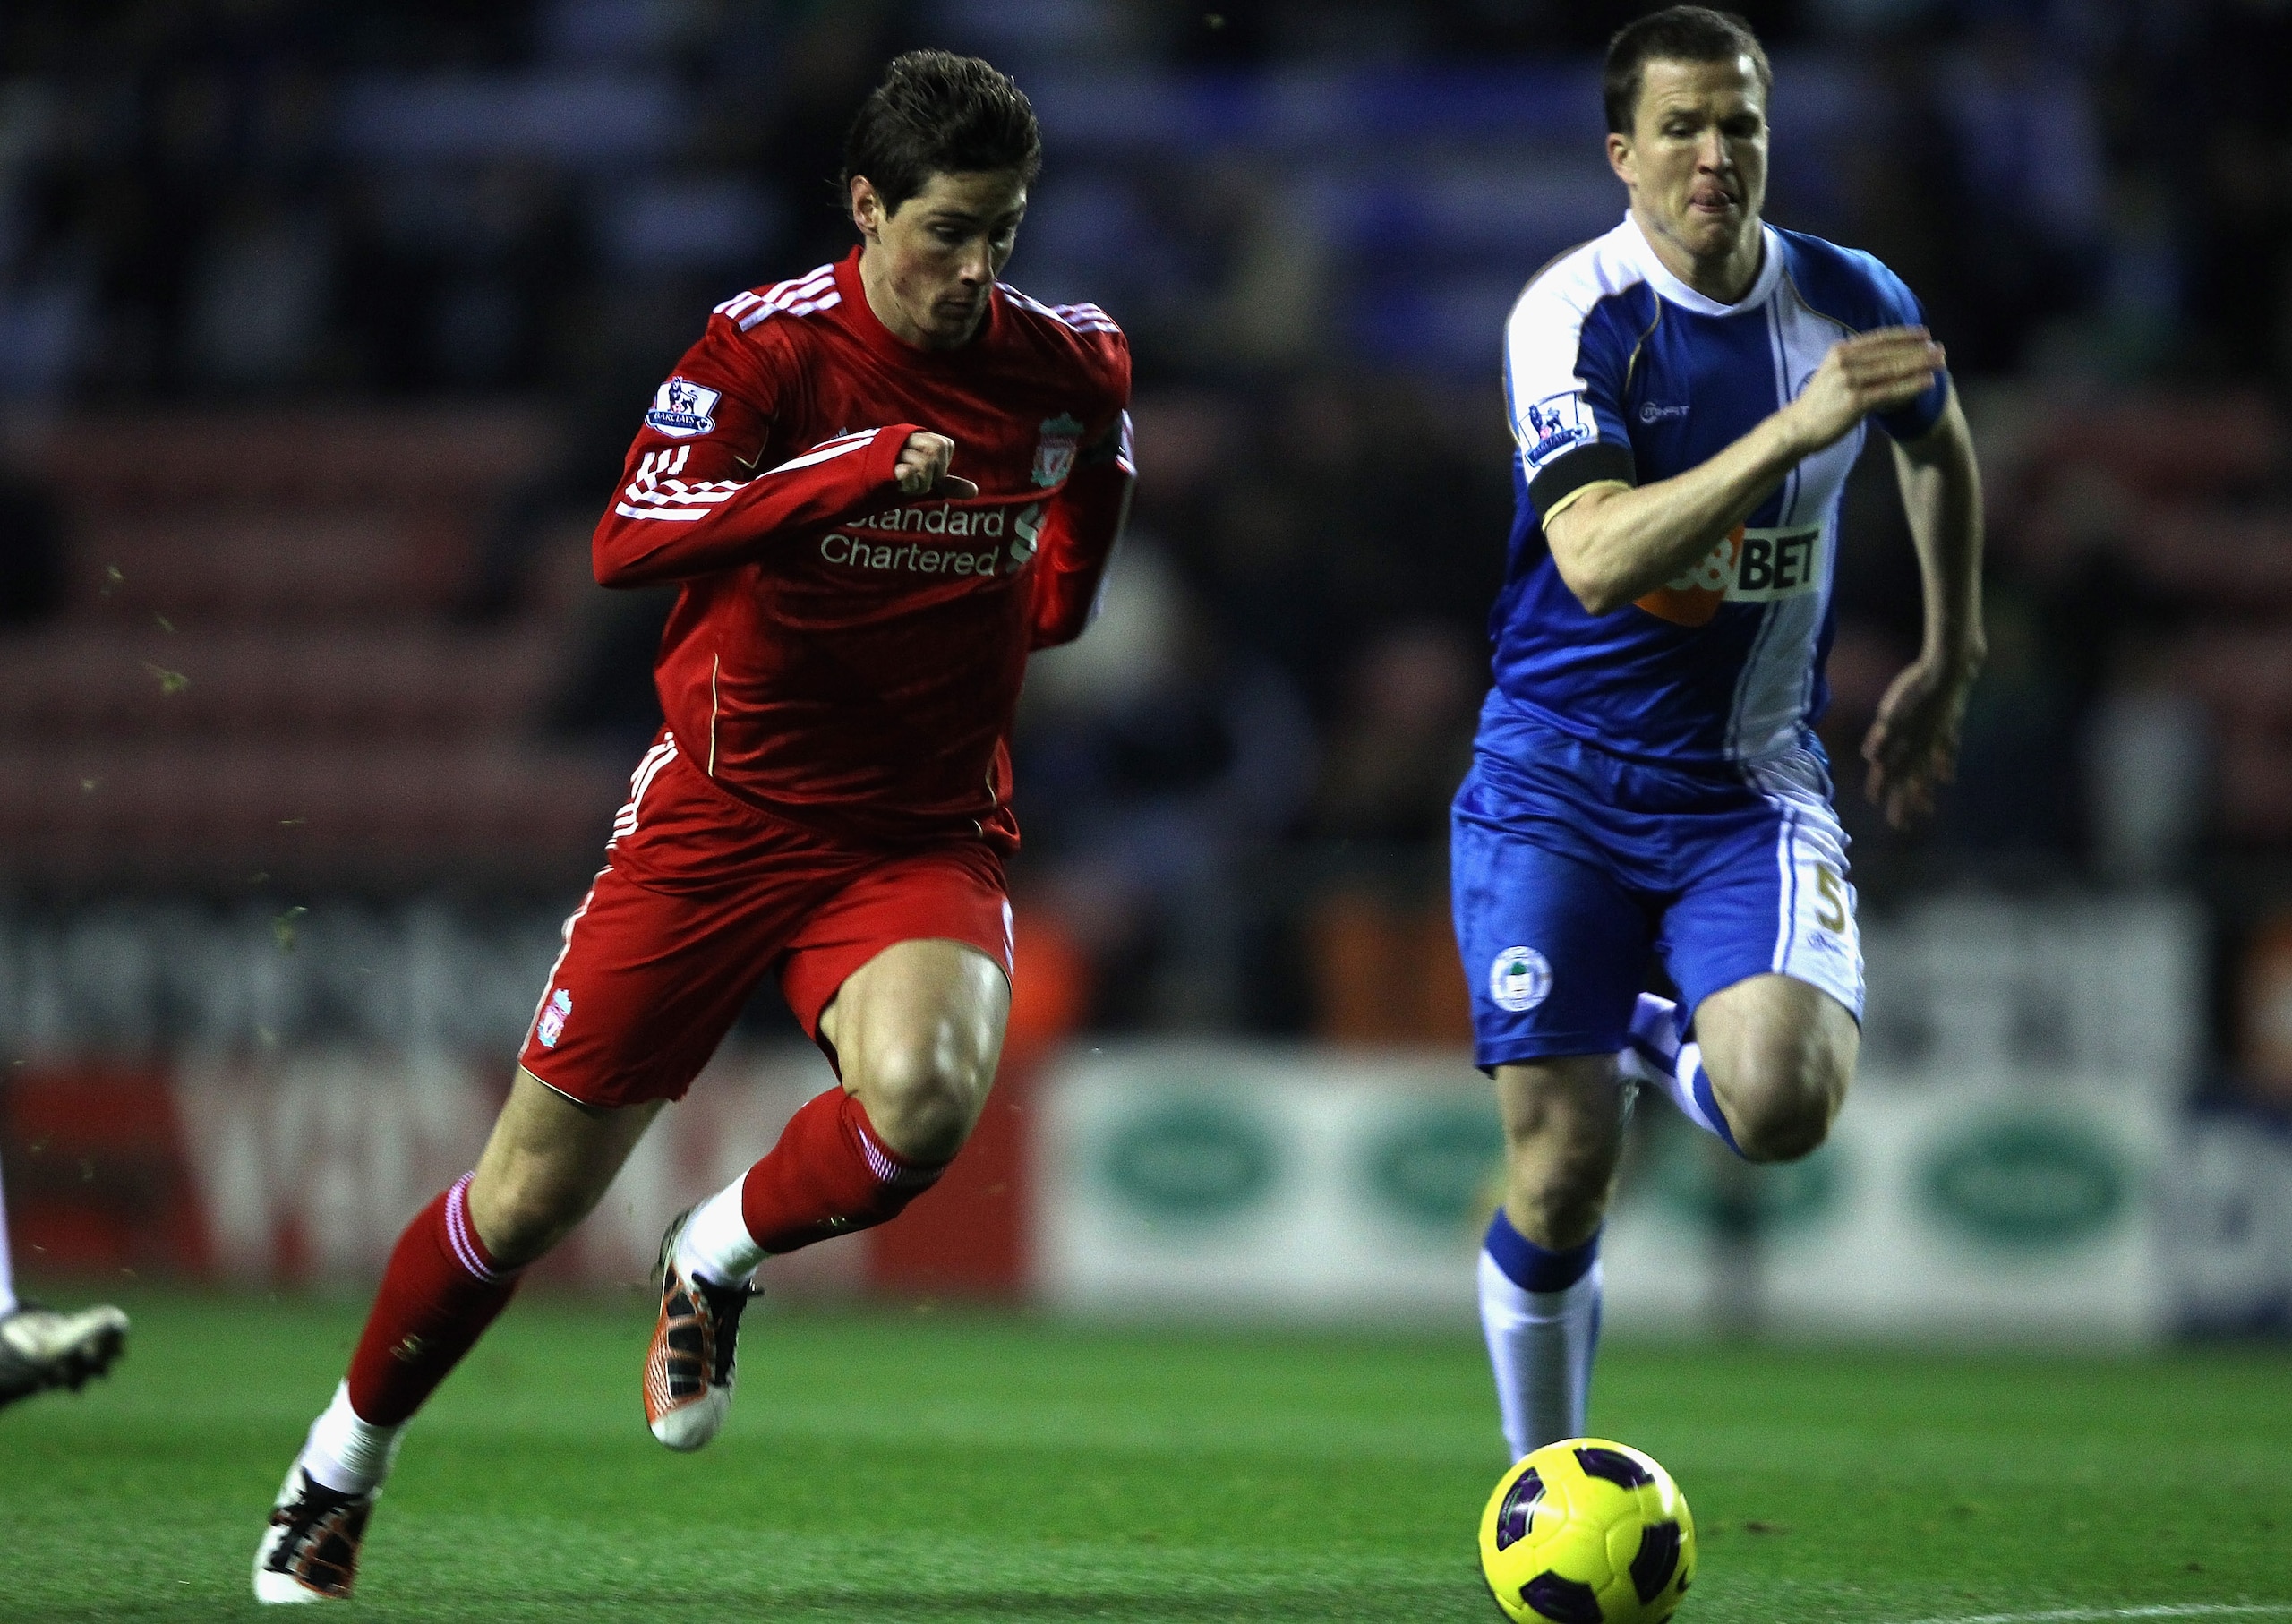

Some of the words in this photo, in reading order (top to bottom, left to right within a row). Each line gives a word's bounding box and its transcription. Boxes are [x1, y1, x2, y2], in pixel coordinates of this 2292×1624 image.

[654, 411, 696, 424] BARCLAYS
[821, 534, 999, 577] Chartered
[1816, 865, 1844, 933] 5
